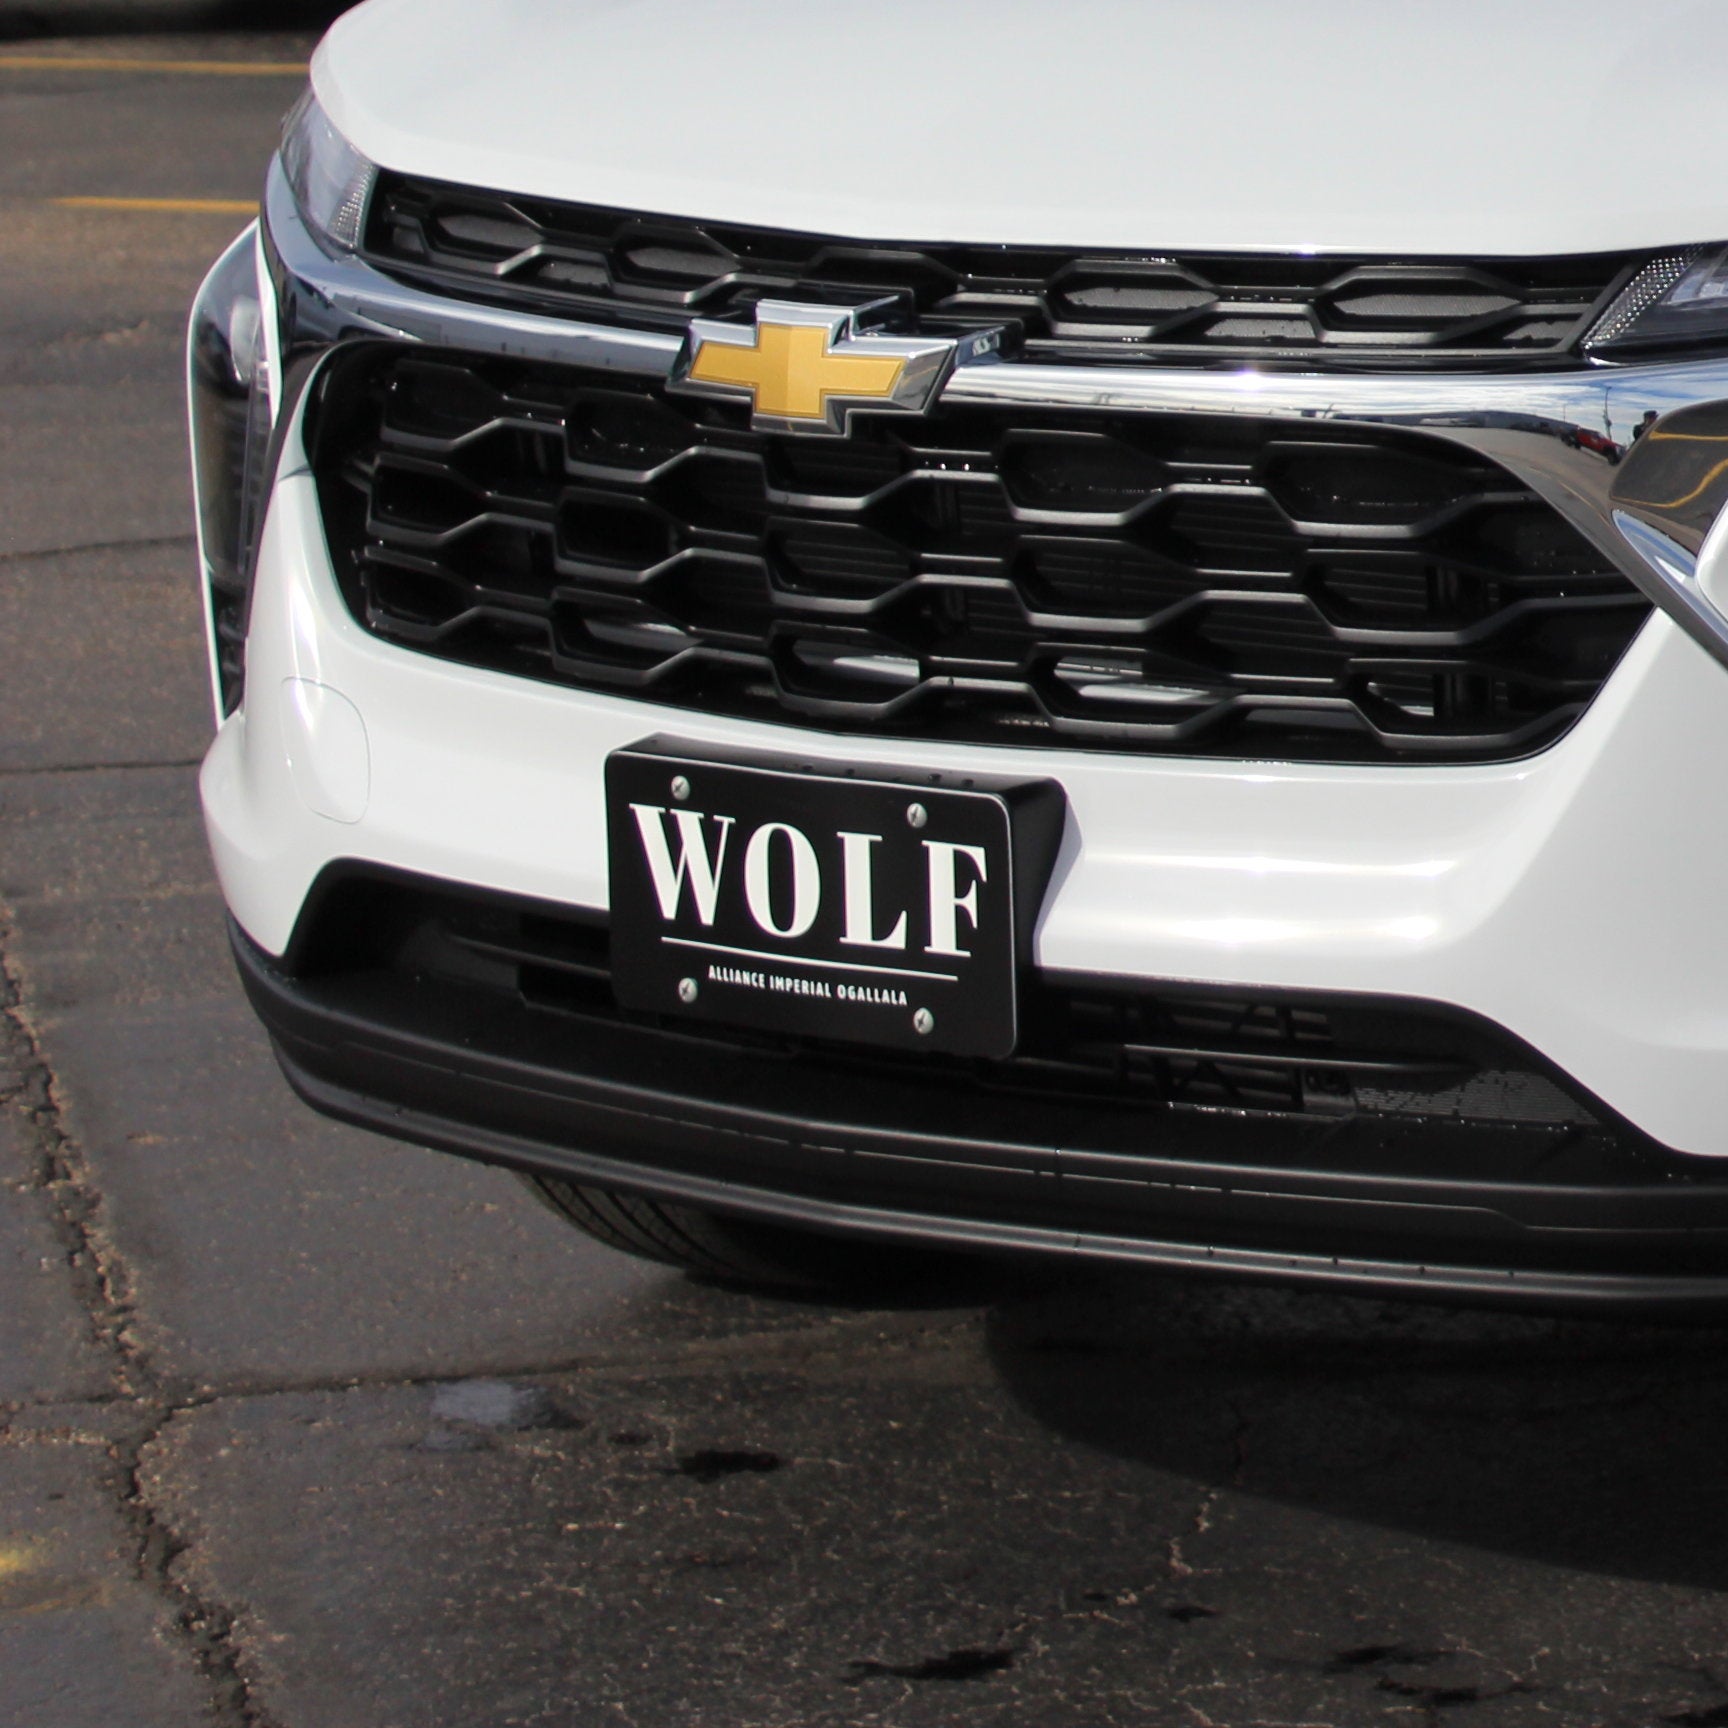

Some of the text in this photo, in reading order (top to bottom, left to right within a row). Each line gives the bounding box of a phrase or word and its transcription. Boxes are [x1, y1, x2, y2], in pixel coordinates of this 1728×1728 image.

[629, 802, 988, 958] WOLF
[708, 964, 908, 1007] ALLIANCE IMPERIAL OGALLALA
